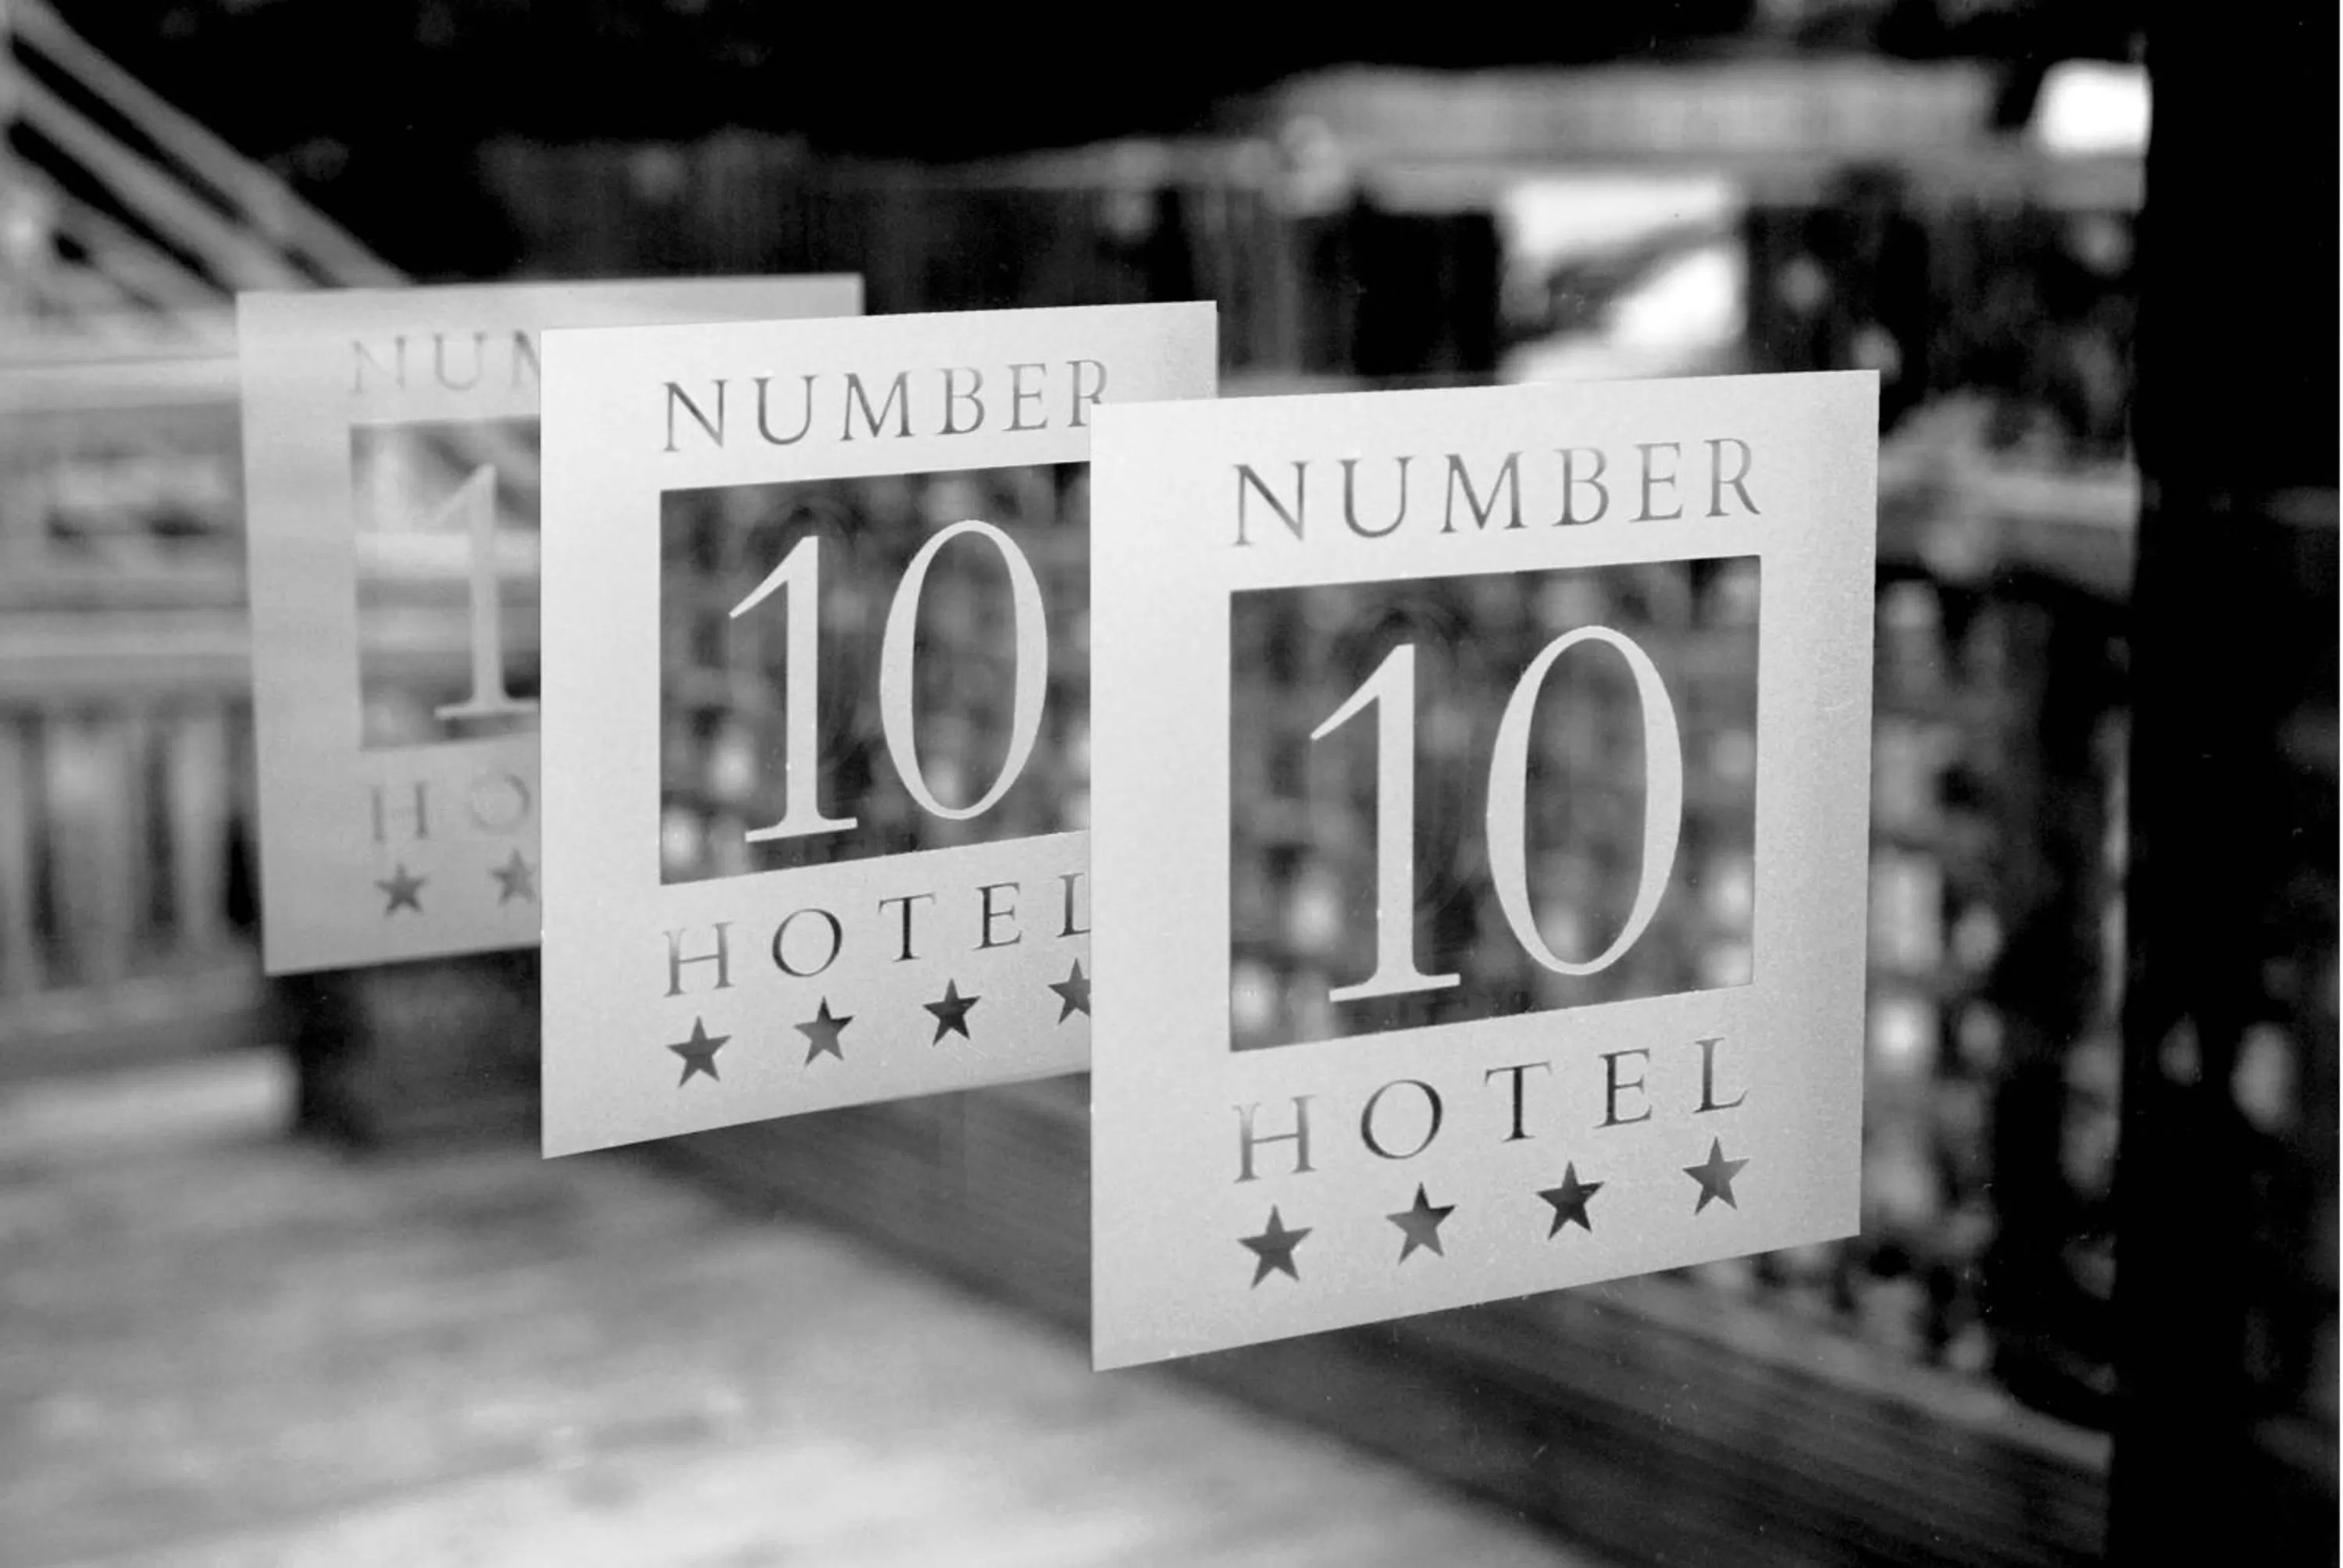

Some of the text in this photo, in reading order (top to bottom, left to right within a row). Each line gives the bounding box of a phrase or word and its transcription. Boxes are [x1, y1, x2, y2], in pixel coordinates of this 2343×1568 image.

[663, 358, 1109, 452] NUMBER
[1229, 437, 1762, 547] NUMBER
[728, 519, 1048, 843] 10
[1310, 625, 1683, 1002] 10
[662, 872, 1092, 998] HOTEL
[1231, 1036, 1749, 1183] HOTEL
